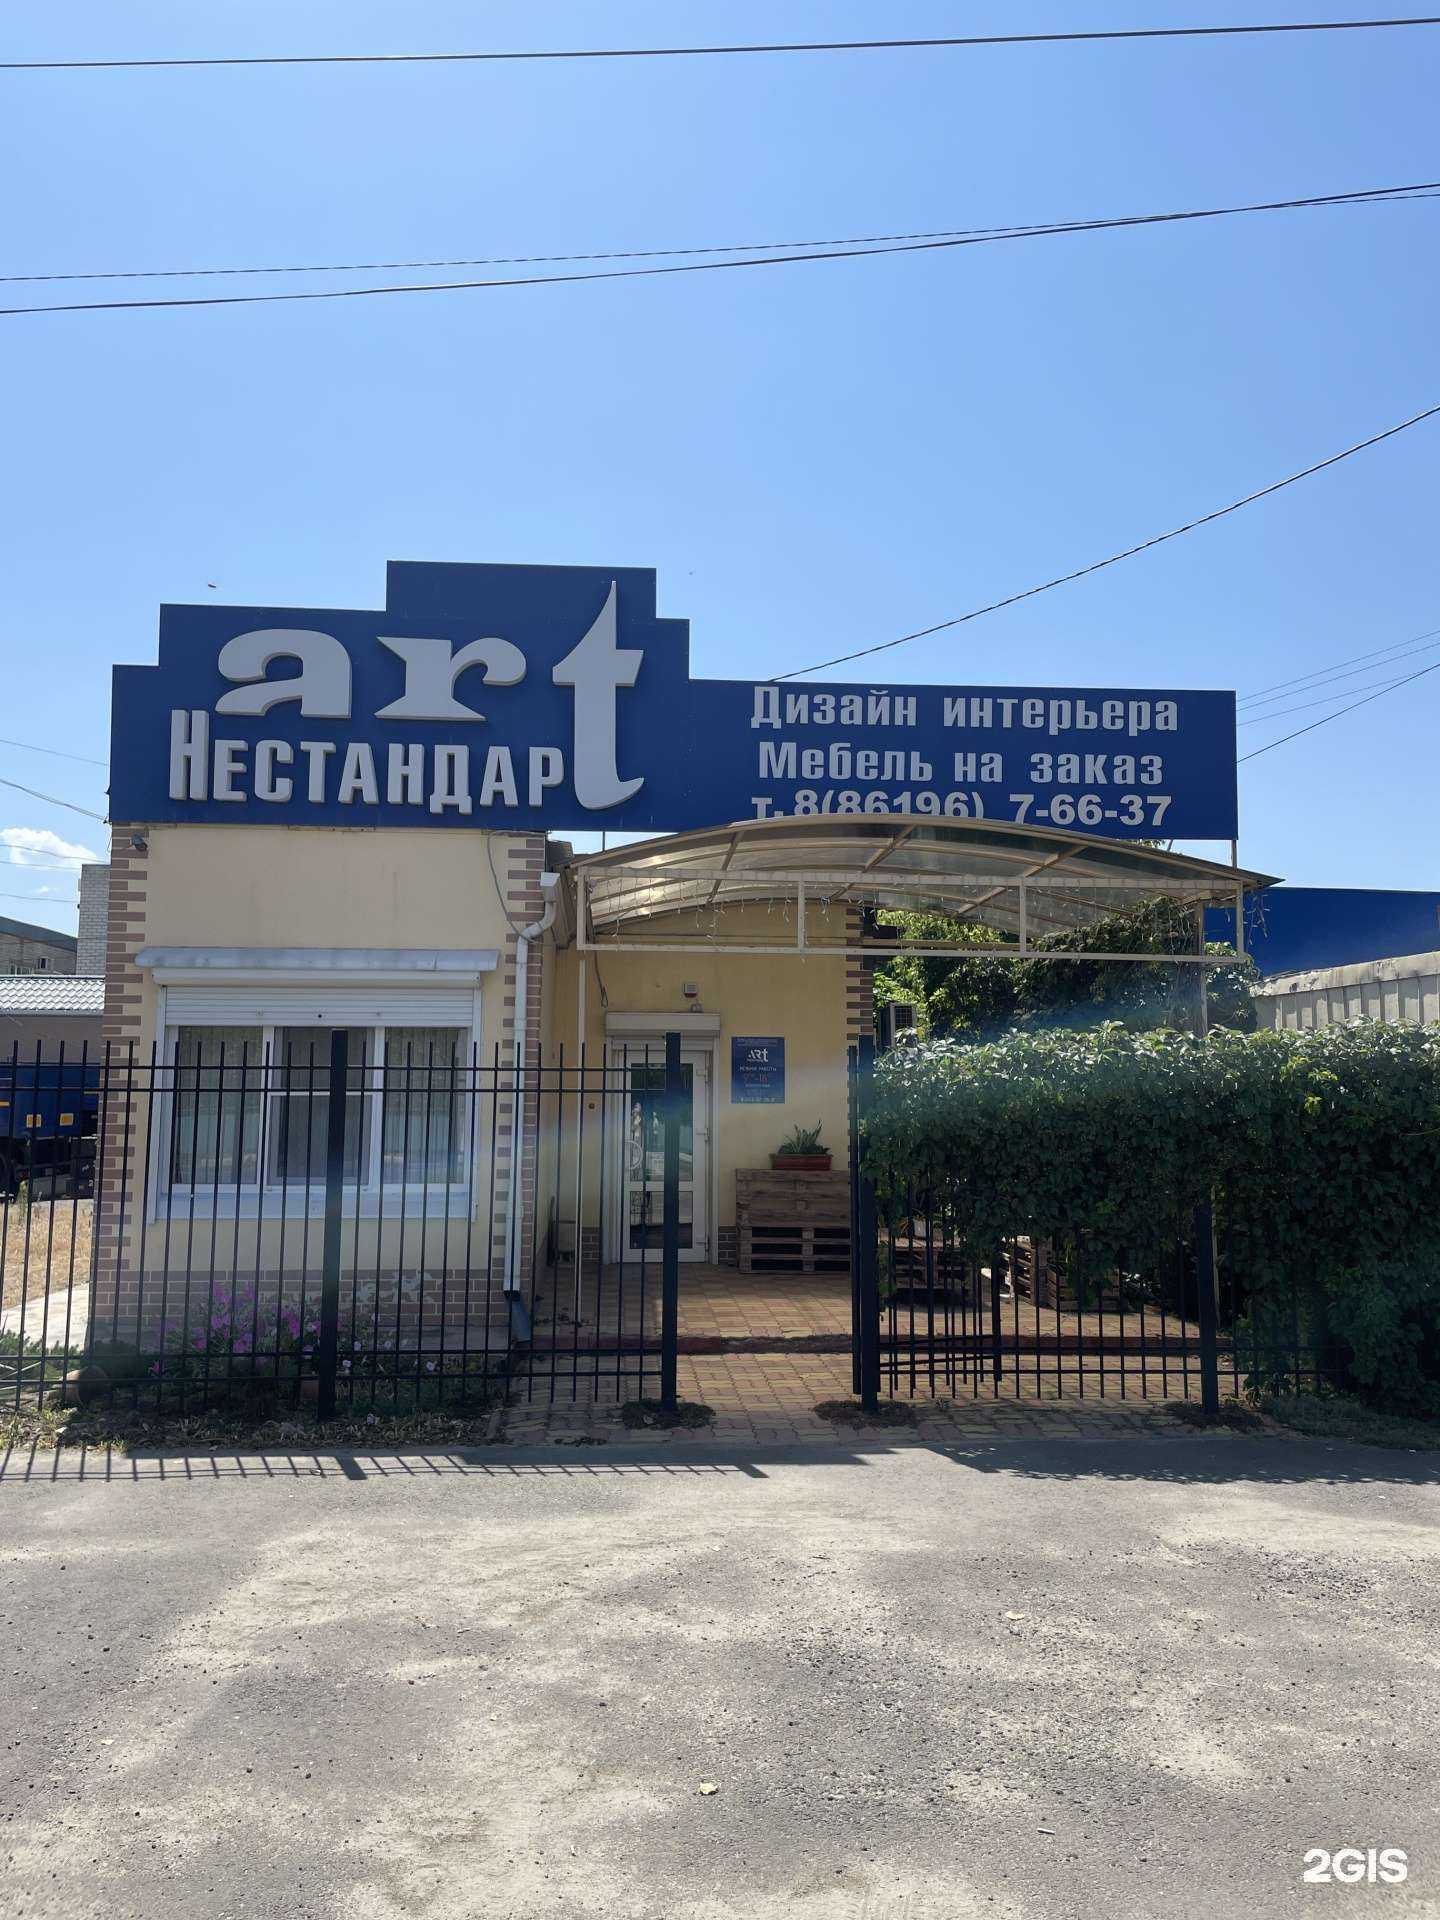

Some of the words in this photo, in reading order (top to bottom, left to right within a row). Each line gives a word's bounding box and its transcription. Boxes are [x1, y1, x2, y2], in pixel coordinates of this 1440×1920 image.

[215, 580, 644, 811] art
[751, 686, 917, 729] Дизайн
[943, 696, 1178, 736] интерьера
[759, 741, 932, 782] Мебель
[954, 752, 1003, 782] на
[1030, 753, 1162, 785] заказ
[1009, 794, 1172, 826] 7-66-37
